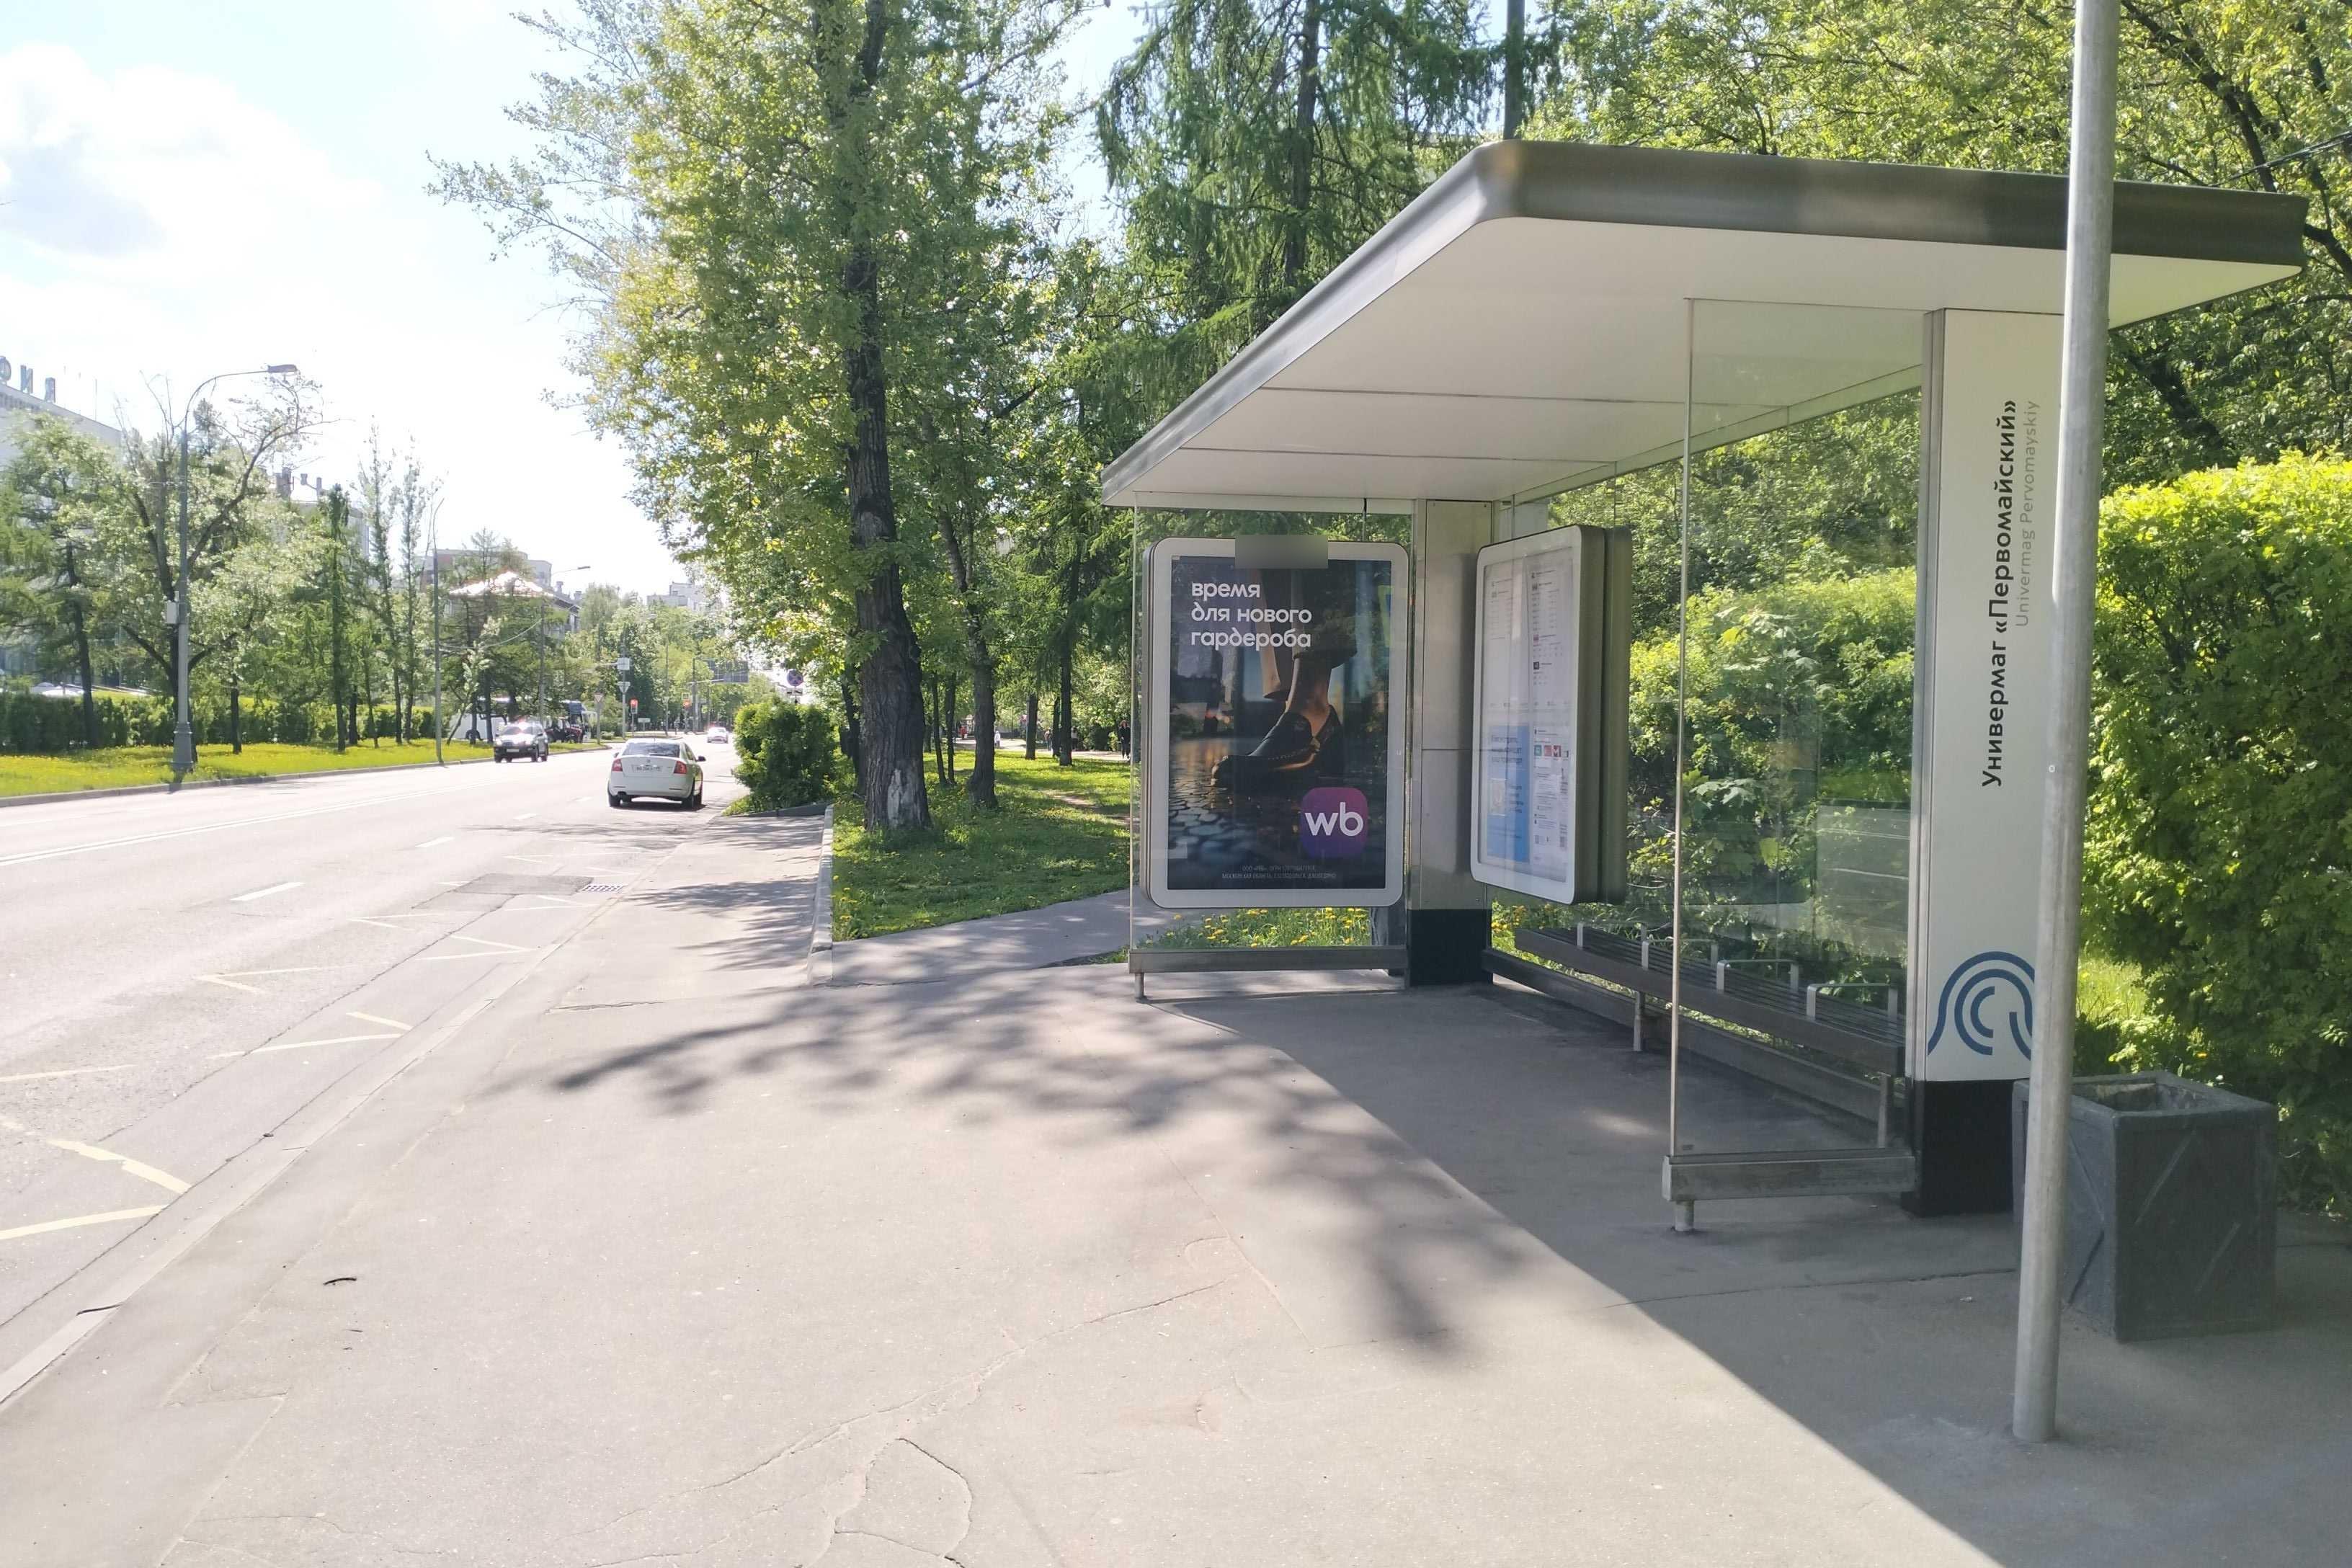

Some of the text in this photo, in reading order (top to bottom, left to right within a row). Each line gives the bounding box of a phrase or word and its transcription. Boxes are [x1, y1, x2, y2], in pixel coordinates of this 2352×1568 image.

[2015, 400, 2041, 627] Univermag Pervomayskiy
[1191, 582, 1260, 600] время
[1982, 400, 2017, 787] Универмаг «Первомайский»
[1191, 602, 1312, 623] для нового
[1191, 627, 1312, 651] гардероба
[1304, 802, 1364, 837] wb
